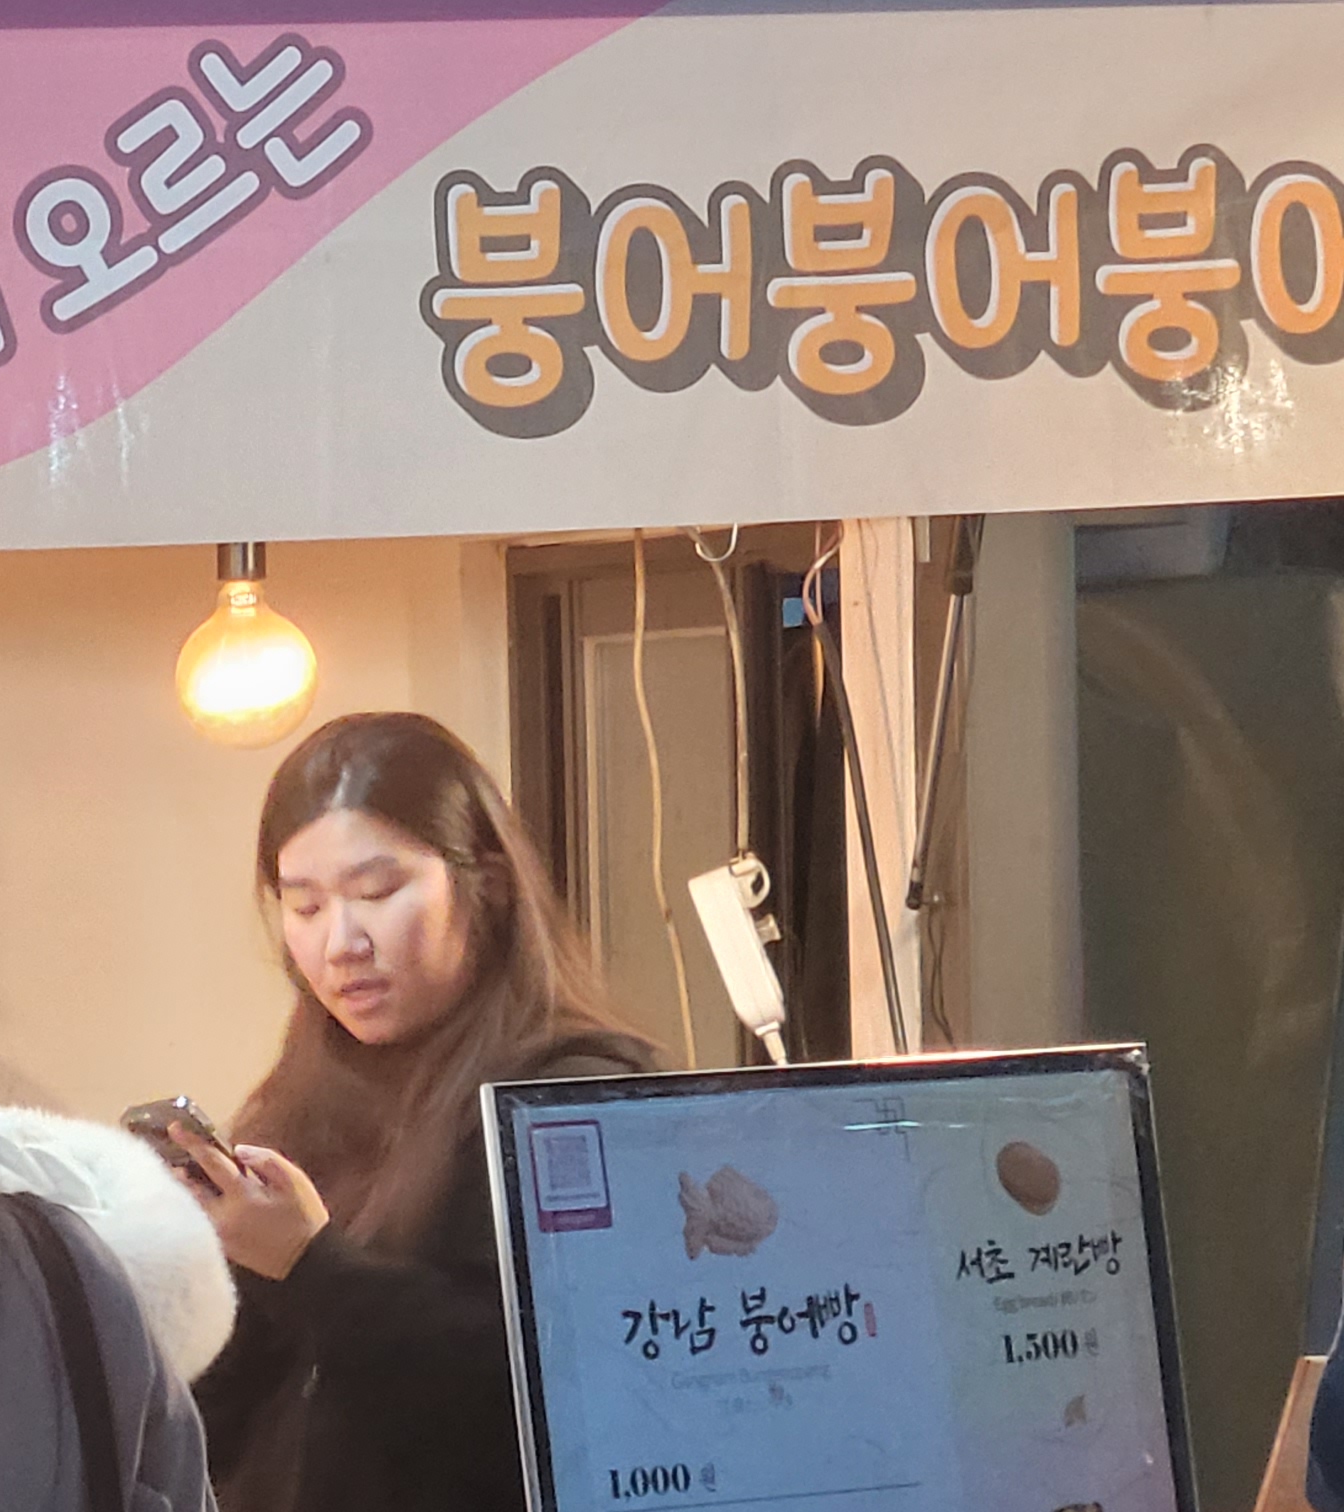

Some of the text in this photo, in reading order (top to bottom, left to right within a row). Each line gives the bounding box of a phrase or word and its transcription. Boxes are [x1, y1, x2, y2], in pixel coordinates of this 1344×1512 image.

[14, 38, 372, 335] 오르는
[956, 1230, 1121, 1284] 서초 계란빵
[621, 1282, 860, 1360] 강남 붕어빵
[609, 1464, 691, 1502] 1,000
